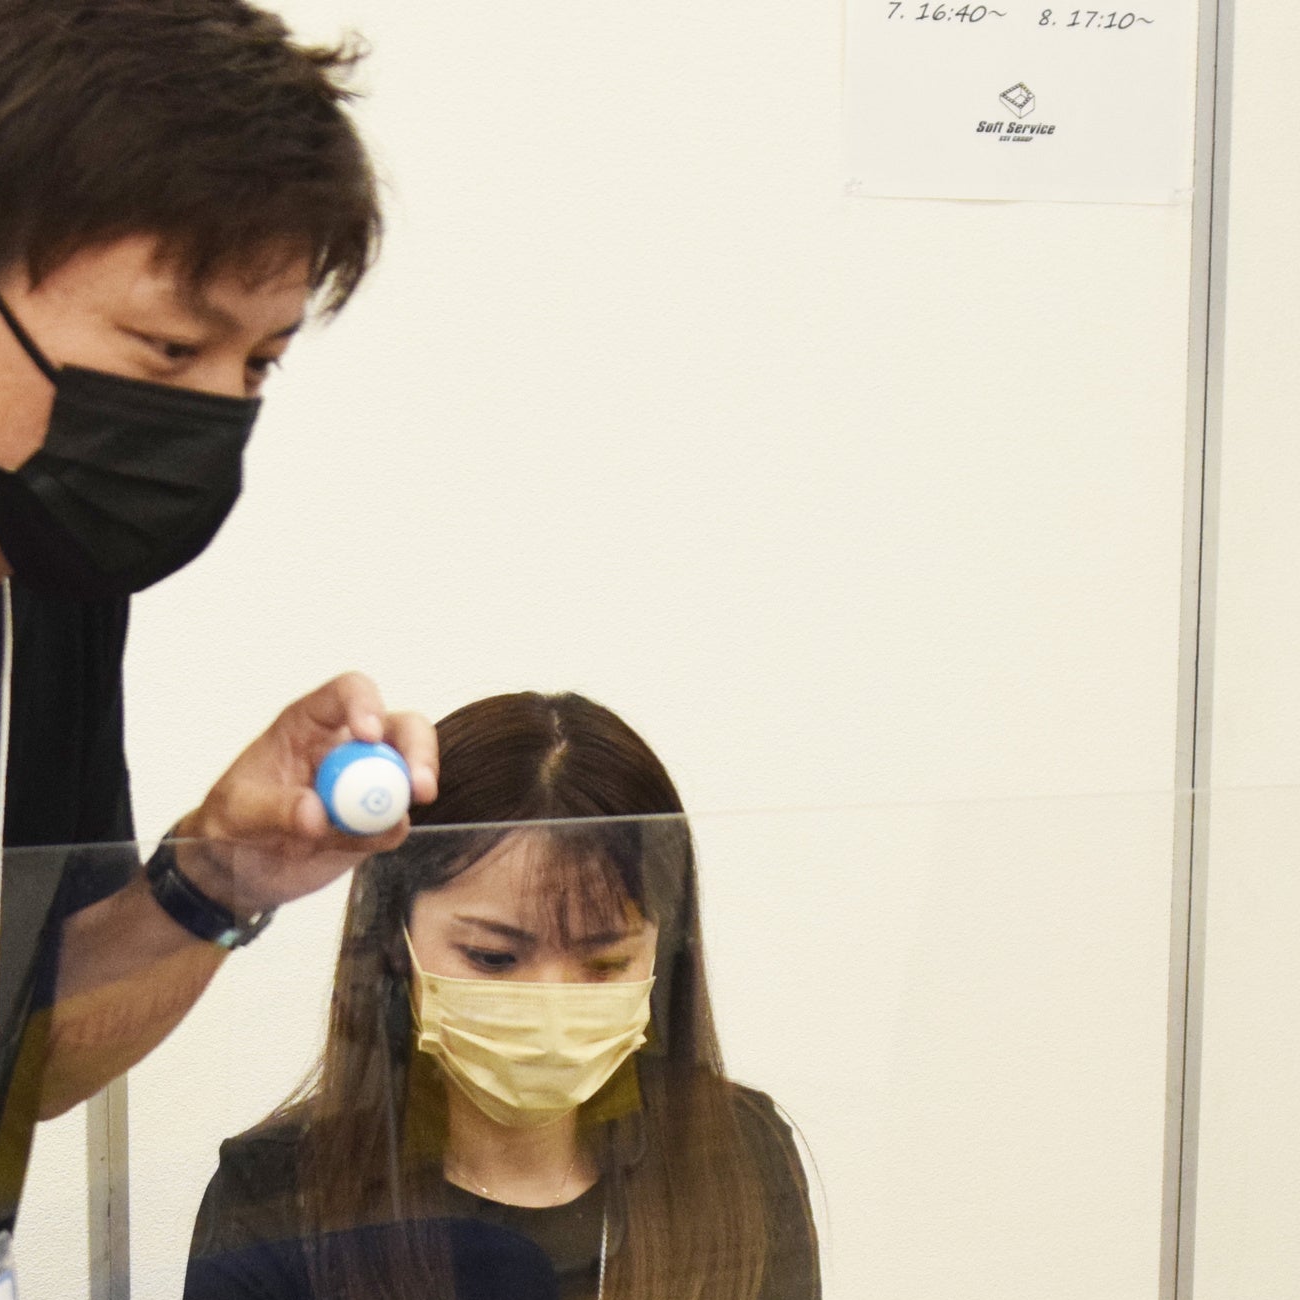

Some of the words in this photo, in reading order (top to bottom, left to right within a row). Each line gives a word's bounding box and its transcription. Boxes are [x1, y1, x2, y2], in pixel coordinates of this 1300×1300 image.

[888, 1, 904, 19] 7.
[1038, 8, 1056, 26] 8.
[976, 120, 1004, 133] Soft
[1006, 121, 1056, 135] Service
